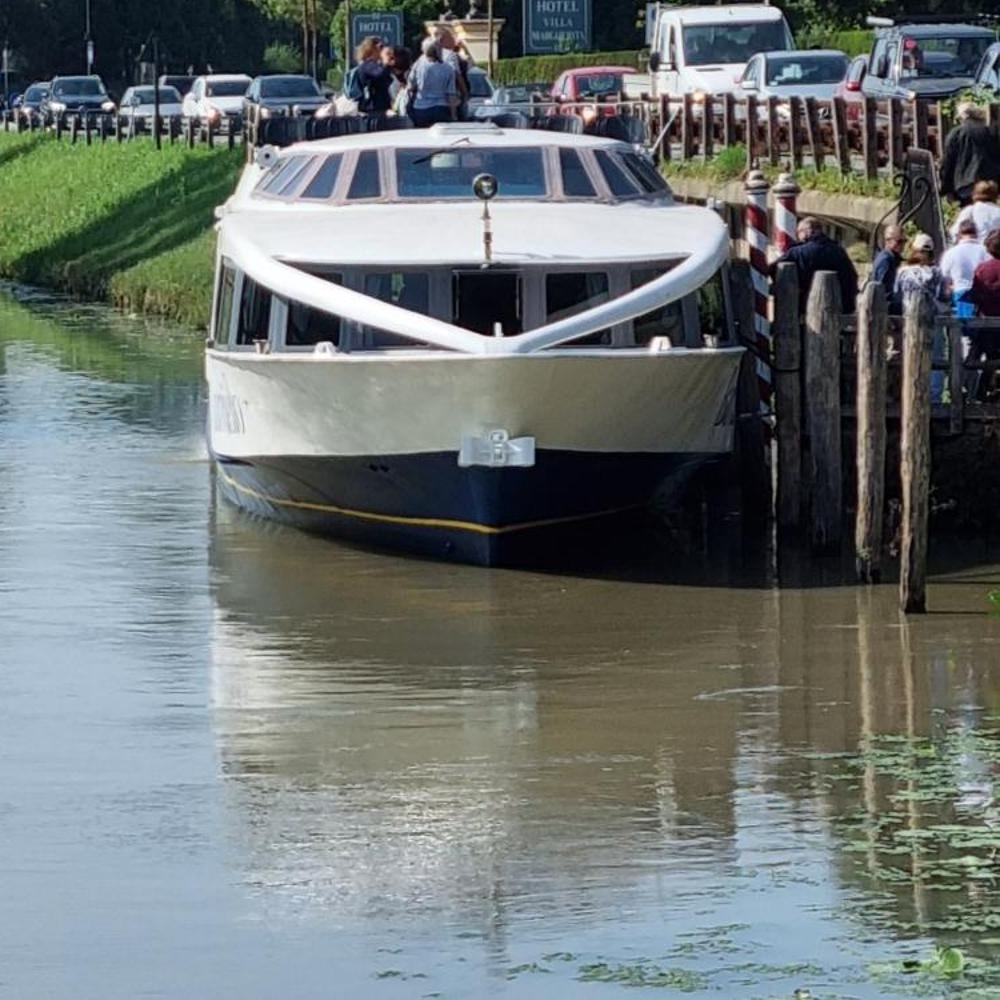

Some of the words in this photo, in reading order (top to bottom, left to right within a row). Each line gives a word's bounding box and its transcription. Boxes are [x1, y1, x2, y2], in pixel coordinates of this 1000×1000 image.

[536, 0, 580, 12] HOTEL
[360, 22, 392, 32] HOTEL
[543, 17, 573, 27] VILLA
